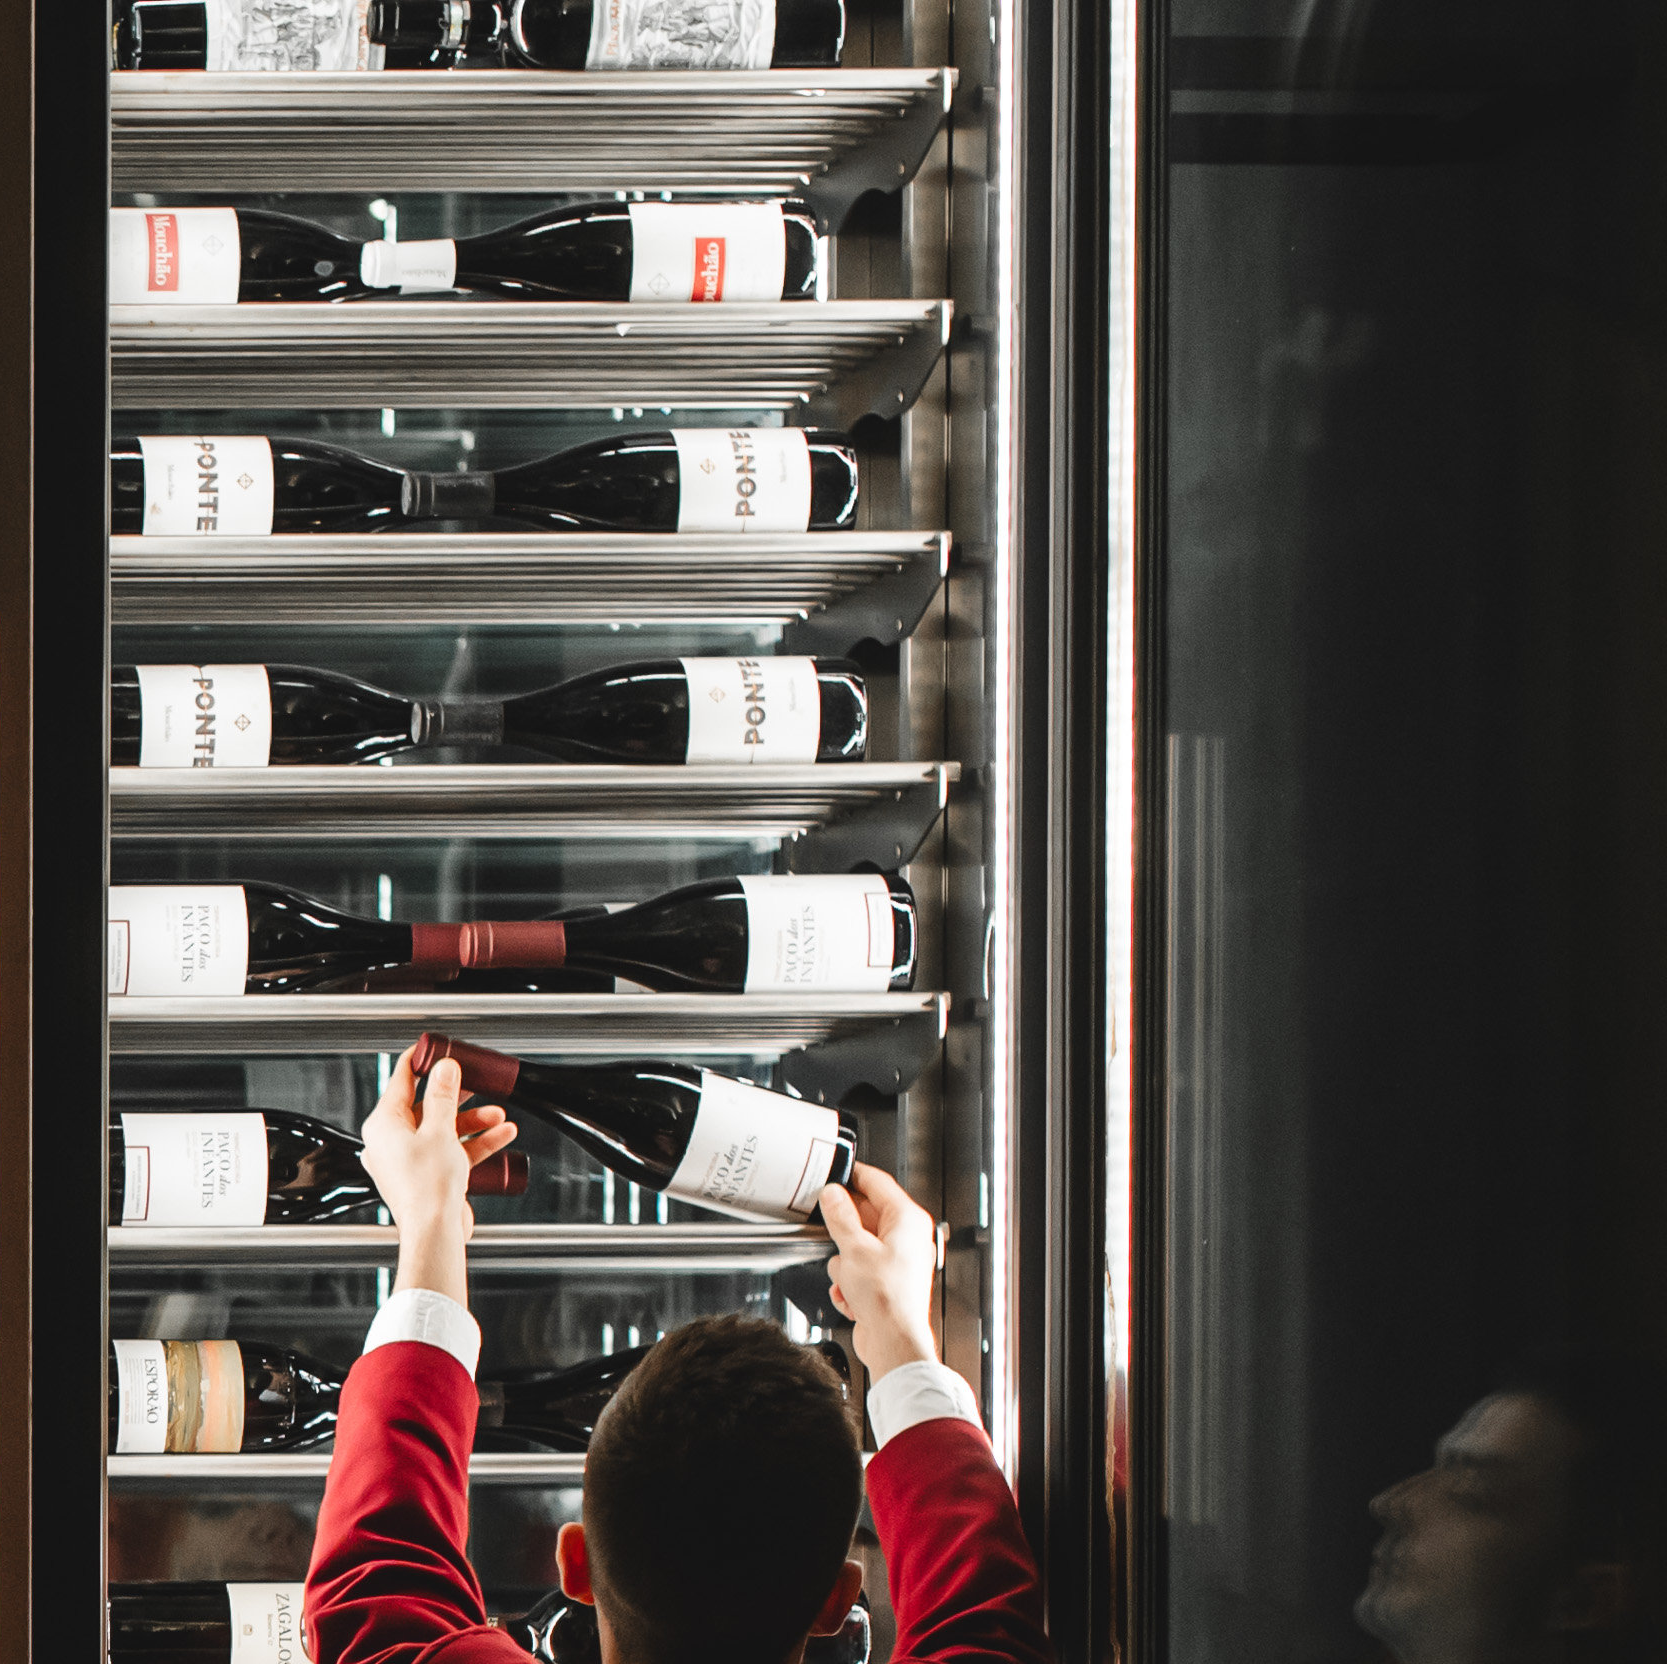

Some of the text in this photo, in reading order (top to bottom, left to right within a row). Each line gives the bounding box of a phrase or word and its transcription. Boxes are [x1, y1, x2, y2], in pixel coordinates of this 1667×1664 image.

[153, 215, 173, 286] Mouchão
[194, 441, 219, 531] PONTE
[727, 431, 757, 517] PONTE
[192, 678, 217, 765] PONTE
[736, 660, 766, 745] PONTE
[181, 905, 195, 983] INFANTES
[194, 904, 211, 970] PAÇO dos
[784, 918, 799, 983] PAÇO dos
[798, 905, 816, 983] INFANTES
[200, 1131, 216, 1208] INFANTES
[215, 1132, 233, 1197] PAÇO dos
[703, 1143, 739, 1199] PAÇO dos
[719, 1134, 760, 1203] INFANTES
[144, 1358, 160, 1424] ESPORÃO
